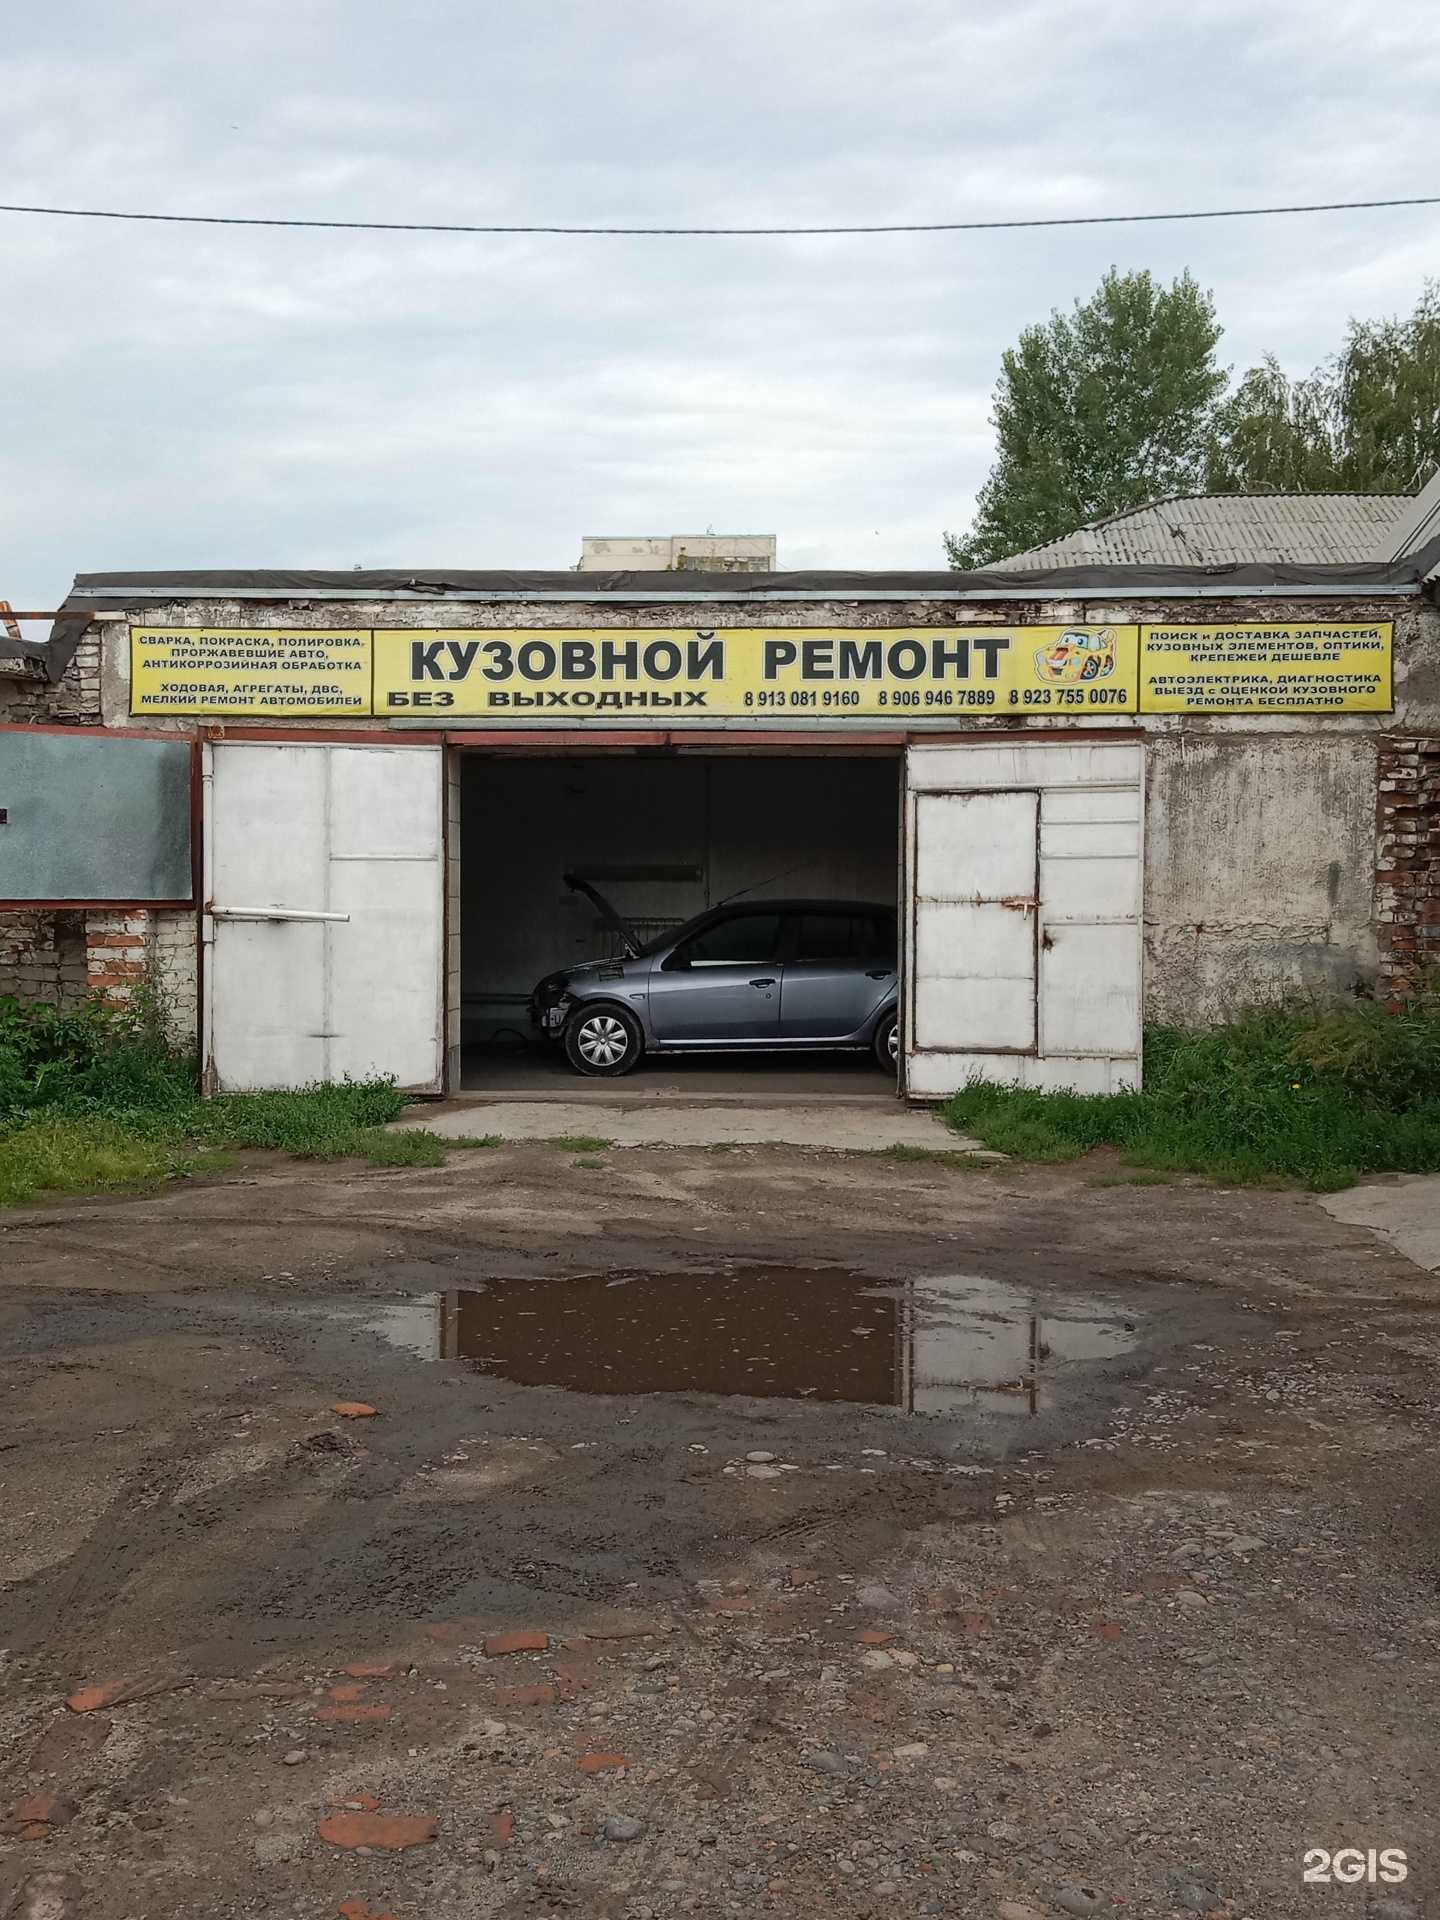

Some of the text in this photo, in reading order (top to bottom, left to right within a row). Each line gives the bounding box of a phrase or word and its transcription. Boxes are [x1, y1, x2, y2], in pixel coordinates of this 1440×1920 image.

[1150, 632, 1198, 640] ПОИСК
[1214, 631, 1290, 641] ДОСТАВКА
[139, 636, 195, 646] СВАРКА,
[200, 637, 274, 647] ПОКРАСКА,
[1147, 643, 1223, 651] КУЗОВНЫХ
[1323, 641, 1384, 651] ОПТИКИ,
[171, 648, 329, 659] ПРОРЖАВЕВШИЕ АВТО,
[410, 631, 1010, 682] КУЗОВНОЙ РЕМОНТ
[1271, 653, 1341, 663] ДЕШЕВЛЕ
[281, 661, 361, 670] ОБРАБОТКА
[1277, 674, 1382, 683] ДИАГНОСТИКА
[161, 683, 343, 694] ХОДОВАЯ, АГРЕГАТЫ, ДВС,
[1154, 687, 1204, 695] ВЫЕЗД
[1220, 685, 1288, 695] ОЦЕНКОЙ
[1293, 685, 1376, 694] КУЗОВНОГО
[201, 695, 256, 705] РЕМОНТ
[387, 691, 708, 708] БЕЗ ВЫХОДНЫХ
[744, 690, 860, 706] 8 913 081 9160
[878, 689, 995, 706] 8 906 946 7889
[1008, 688, 1127, 705] 8 923 755 0076
[1187, 697, 1344, 705] РЕМОНТА БЕСПЛАТНО
